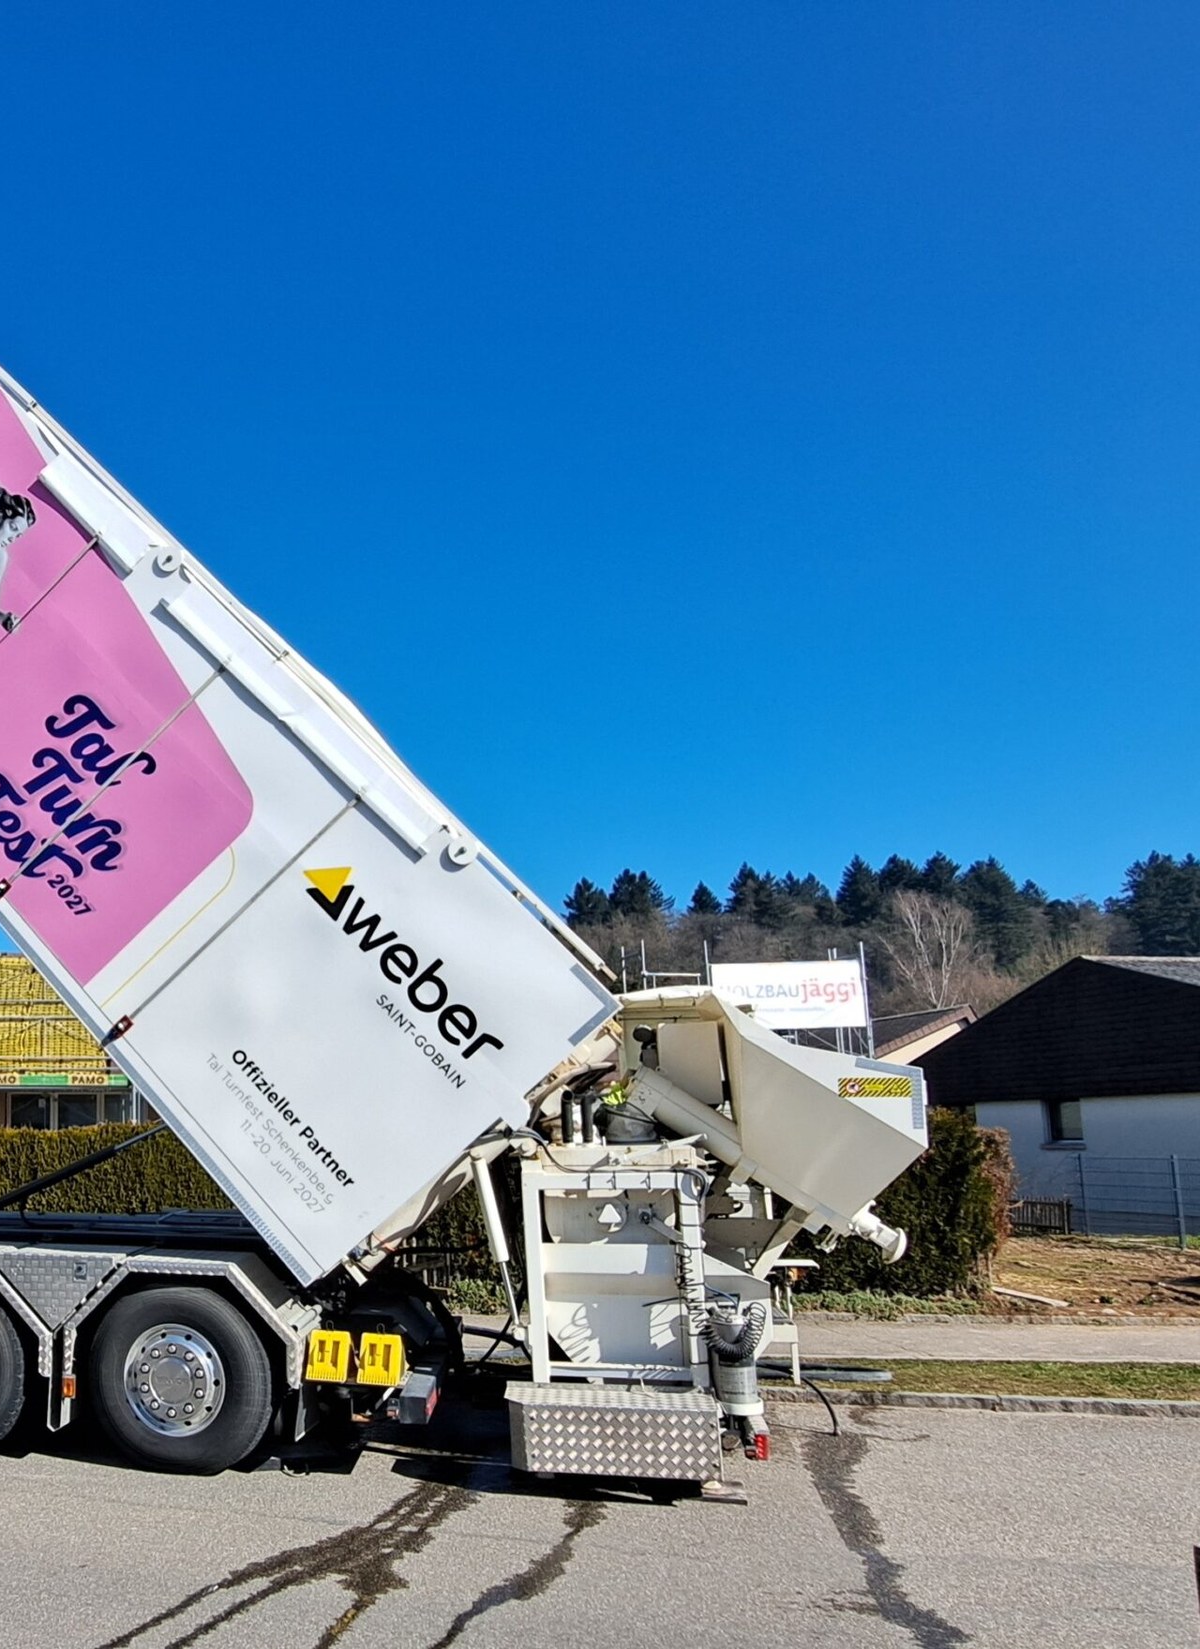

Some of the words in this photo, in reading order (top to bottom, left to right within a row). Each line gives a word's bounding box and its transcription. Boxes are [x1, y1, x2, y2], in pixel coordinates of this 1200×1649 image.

[45, 694, 156, 787] Tal
[23, 747, 122, 871] Turn
[47, 874, 92, 916] 2027
[342, 896, 504, 1059] weber
[71, 1075, 105, 1084] PAMO
[206, 1053, 223, 1073] Tal
[222, 1072, 264, 1121] Turnfest
[376, 994, 466, 1089] SAINT-GOBAIN
[232, 1050, 301, 1127] Offizieller
[299, 1126, 355, 1187] Partner
[271, 1160, 296, 1185] Juni
[293, 1183, 326, 1214] 2027
